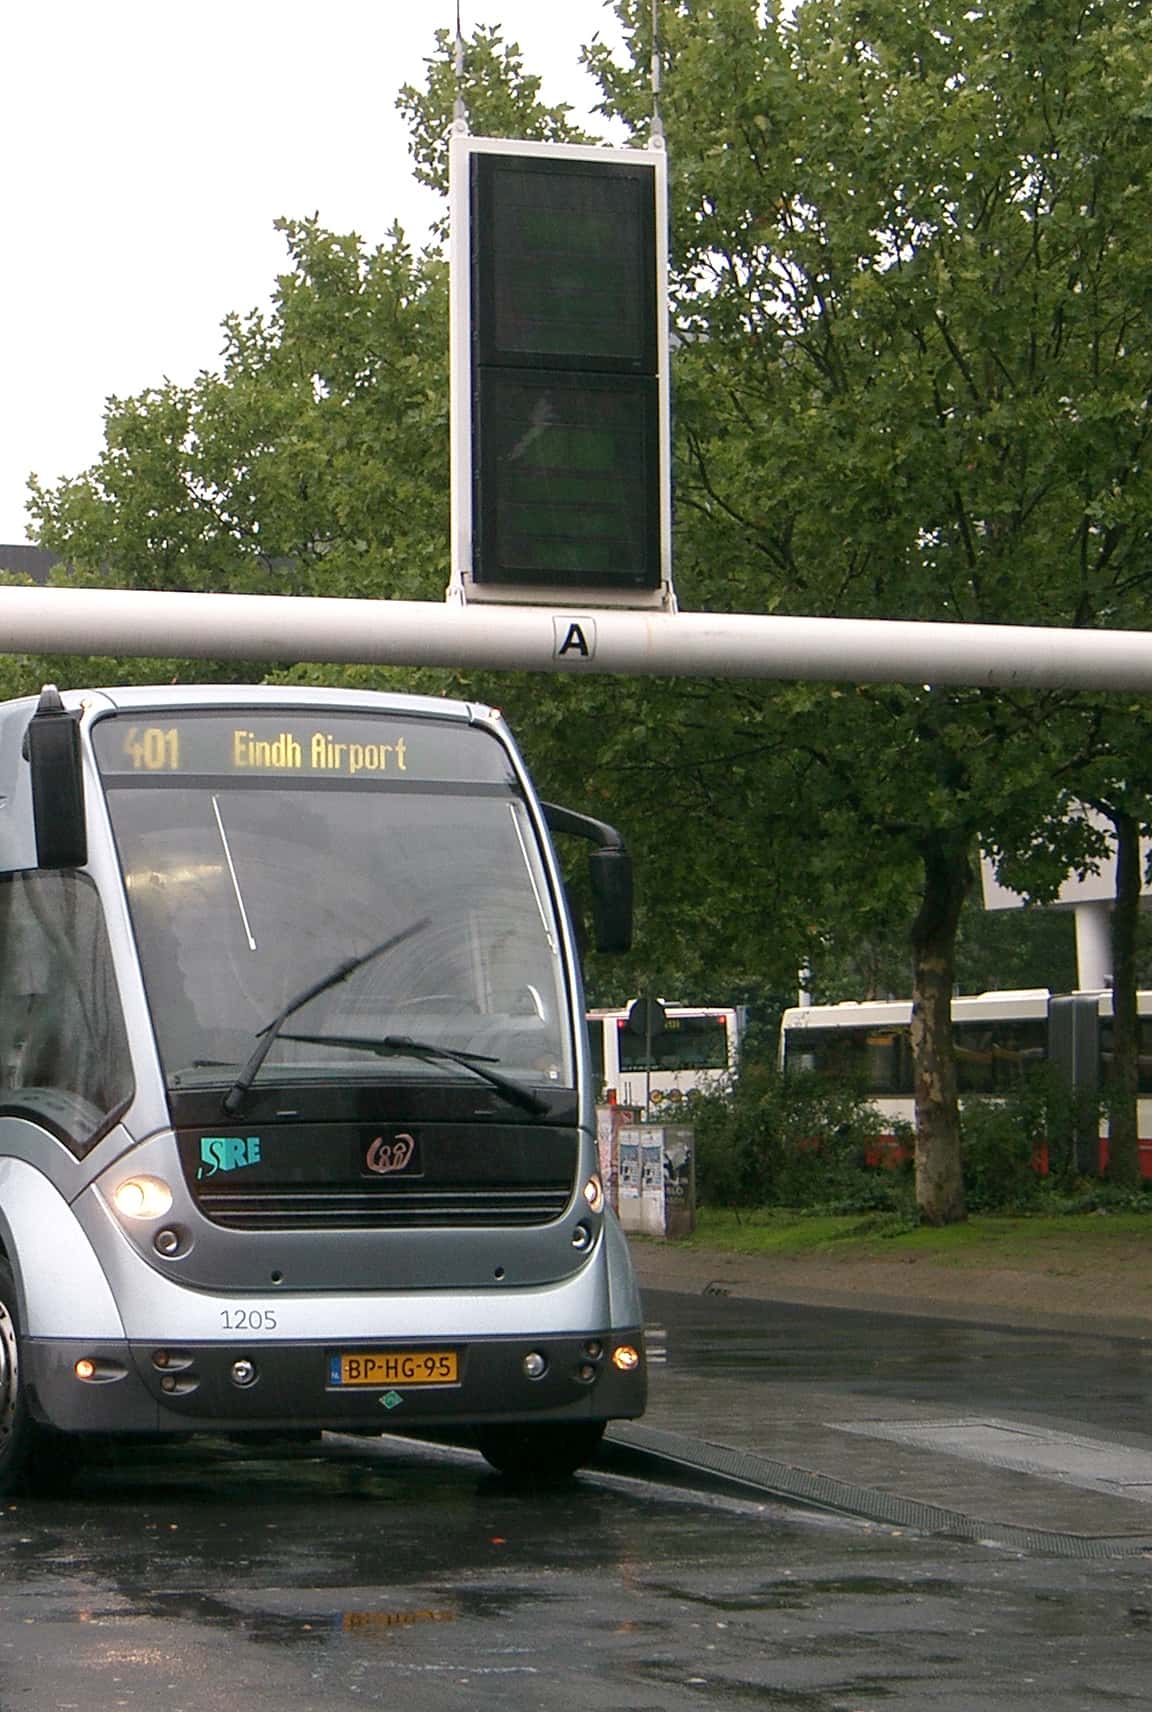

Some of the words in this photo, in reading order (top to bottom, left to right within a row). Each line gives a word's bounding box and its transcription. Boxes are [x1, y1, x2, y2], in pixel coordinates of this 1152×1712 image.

[558, 623, 590, 657] A
[123, 727, 180, 770] 401
[234, 730, 302, 769] Eindh
[311, 732, 408, 774] Airport
[221, 1310, 278, 1331] 1205
[348, 1356, 451, 1380] BP-HG-95
